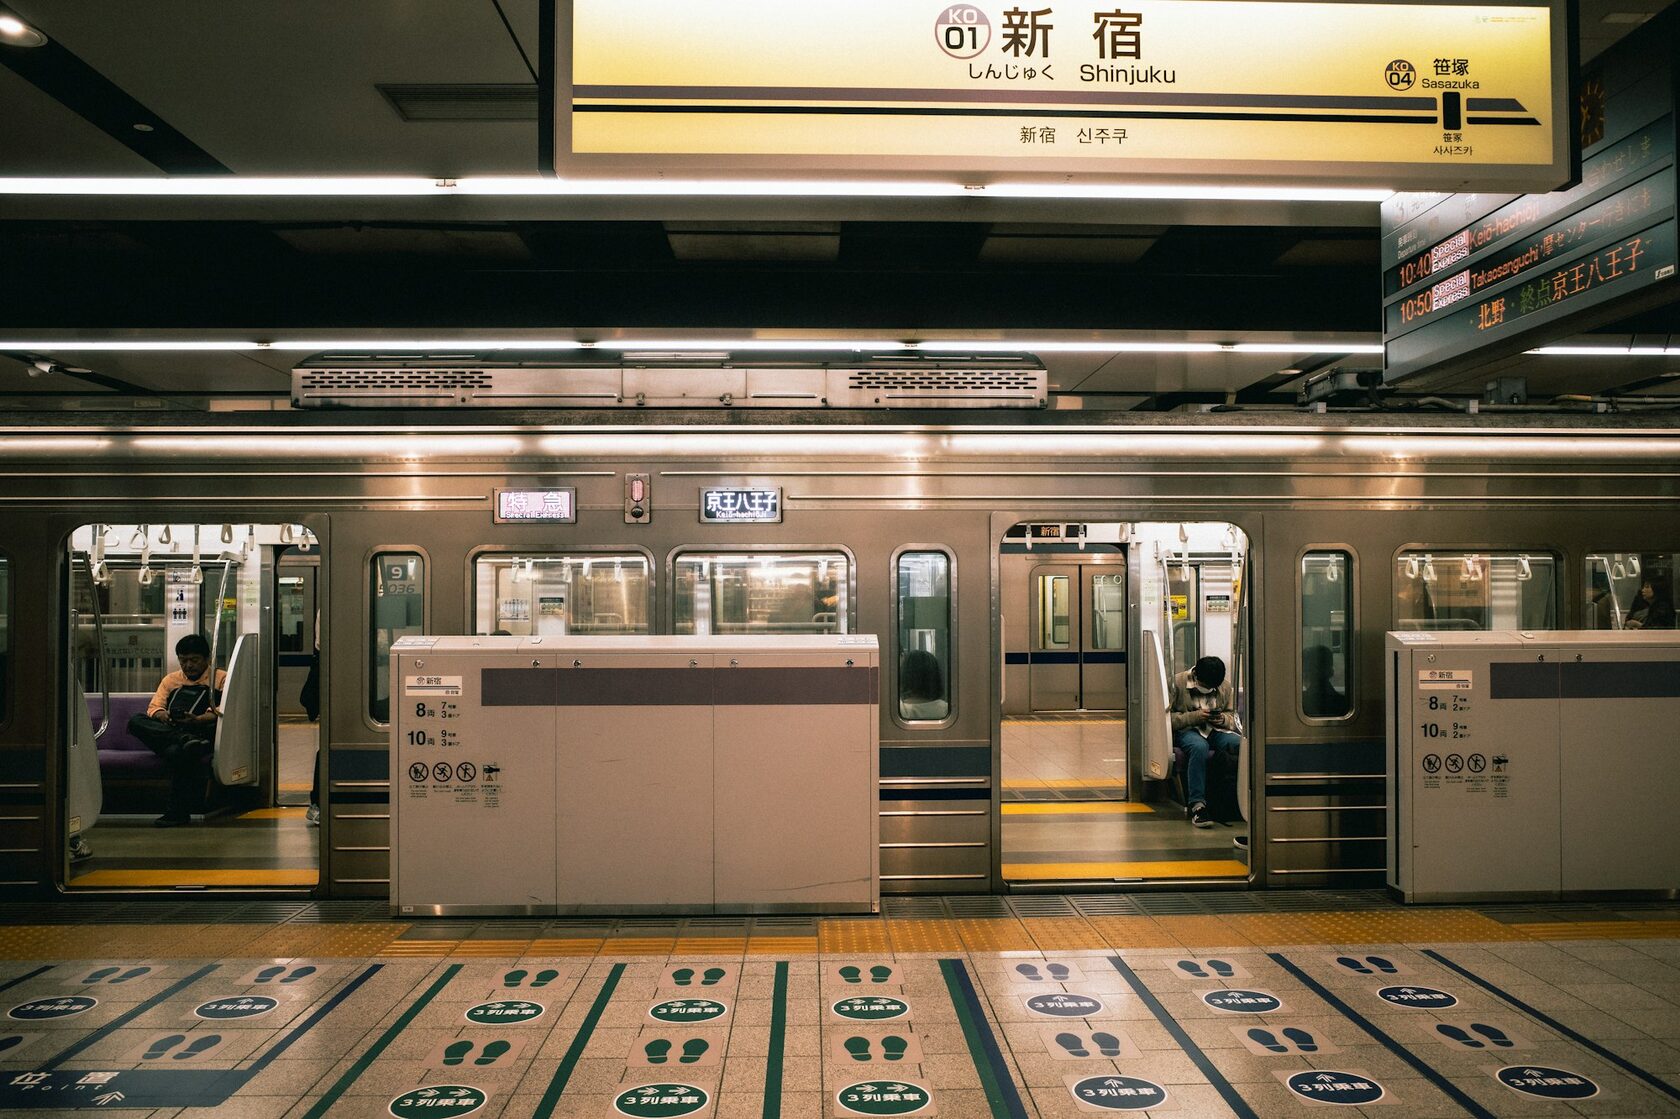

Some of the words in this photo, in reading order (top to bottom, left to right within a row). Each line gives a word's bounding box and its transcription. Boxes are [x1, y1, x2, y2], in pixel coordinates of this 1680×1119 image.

[948, 9, 977, 24] KO
[945, 26, 978, 50] 01
[1001, 6, 1143, 60] 新宿
[968, 63, 1055, 81] しんじゅく
[1079, 64, 1176, 85] Shinjuku
[1392, 62, 1408, 71] KO
[1433, 58, 1469, 76] 笹塚
[1389, 72, 1412, 86] 04
[1422, 78, 1480, 89] Sasazuka
[1019, 126, 1056, 144] 新宿
[1076, 127, 1129, 145] 신주쿠
[1433, 145, 1473, 155] 사사즈카
[1400, 253, 1431, 287] 10:40
[1432, 234, 1468, 260] Special
[1432, 247, 1468, 272] Express
[1401, 291, 1432, 324] 10:50
[1433, 274, 1468, 298] Special
[1471, 245, 1539, 288] Takaosanguchi
[1433, 286, 1468, 311] Express
[1478, 298, 1505, 330] 北野
[507, 492, 563, 511] 特急
[706, 491, 777, 512] 京王八王子
[391, 566, 403, 580] 9
[9, 1072, 120, 1085] 位置
